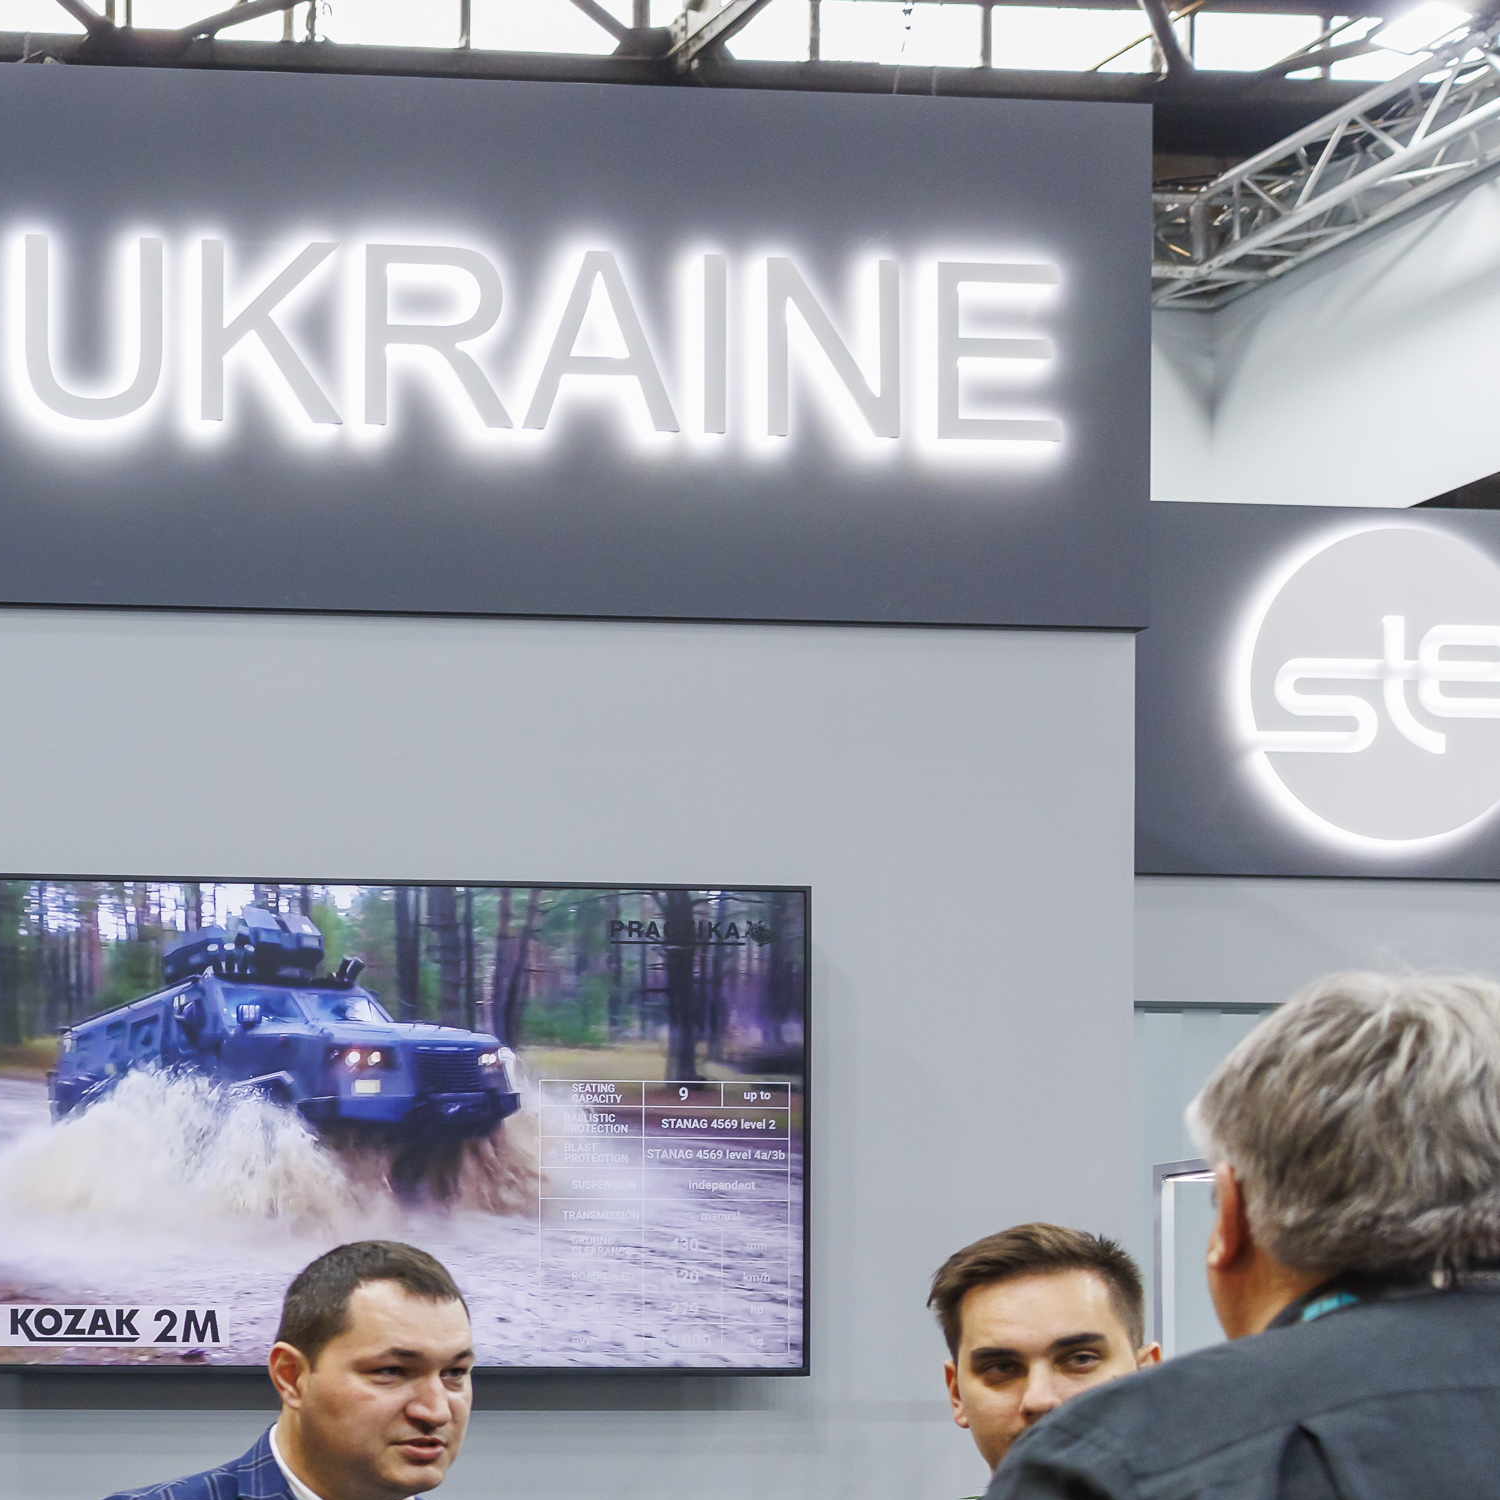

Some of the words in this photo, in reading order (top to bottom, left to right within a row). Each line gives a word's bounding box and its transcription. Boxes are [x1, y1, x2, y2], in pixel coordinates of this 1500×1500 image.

[21, 233, 1064, 444] UKRAINE
[610, 920, 741, 939] PRAIKA
[571, 1083, 616, 1093] SEATING
[571, 1094, 623, 1104] CAPACITY
[679, 1087, 689, 1101] 9
[743, 1091, 758, 1102] up
[760, 1090, 771, 1101] to
[564, 1113, 616, 1123] BALLISTIC
[564, 1123, 629, 1134] PROTECTION
[661, 1118, 708, 1129] STANAG
[711, 1118, 738, 1129] 4569
[740, 1119, 766, 1130] level
[768, 1119, 776, 1130] 2
[564, 1142, 598, 1152] BLAST
[564, 1153, 629, 1163] PROTECTION
[646, 1149, 694, 1160] STANAG
[696, 1149, 723, 1160] 4569
[726, 1149, 752, 1160] level
[754, 1150, 786, 1162] 4a/3b
[571, 1180, 637, 1190] SUSPENSION
[688, 1180, 756, 1192] independent
[562, 1210, 640, 1221] TRANSMISSION
[701, 1211, 741, 1221] manual
[10, 1308, 141, 1342] KOZAK
[153, 1309, 220, 1343] 2M
